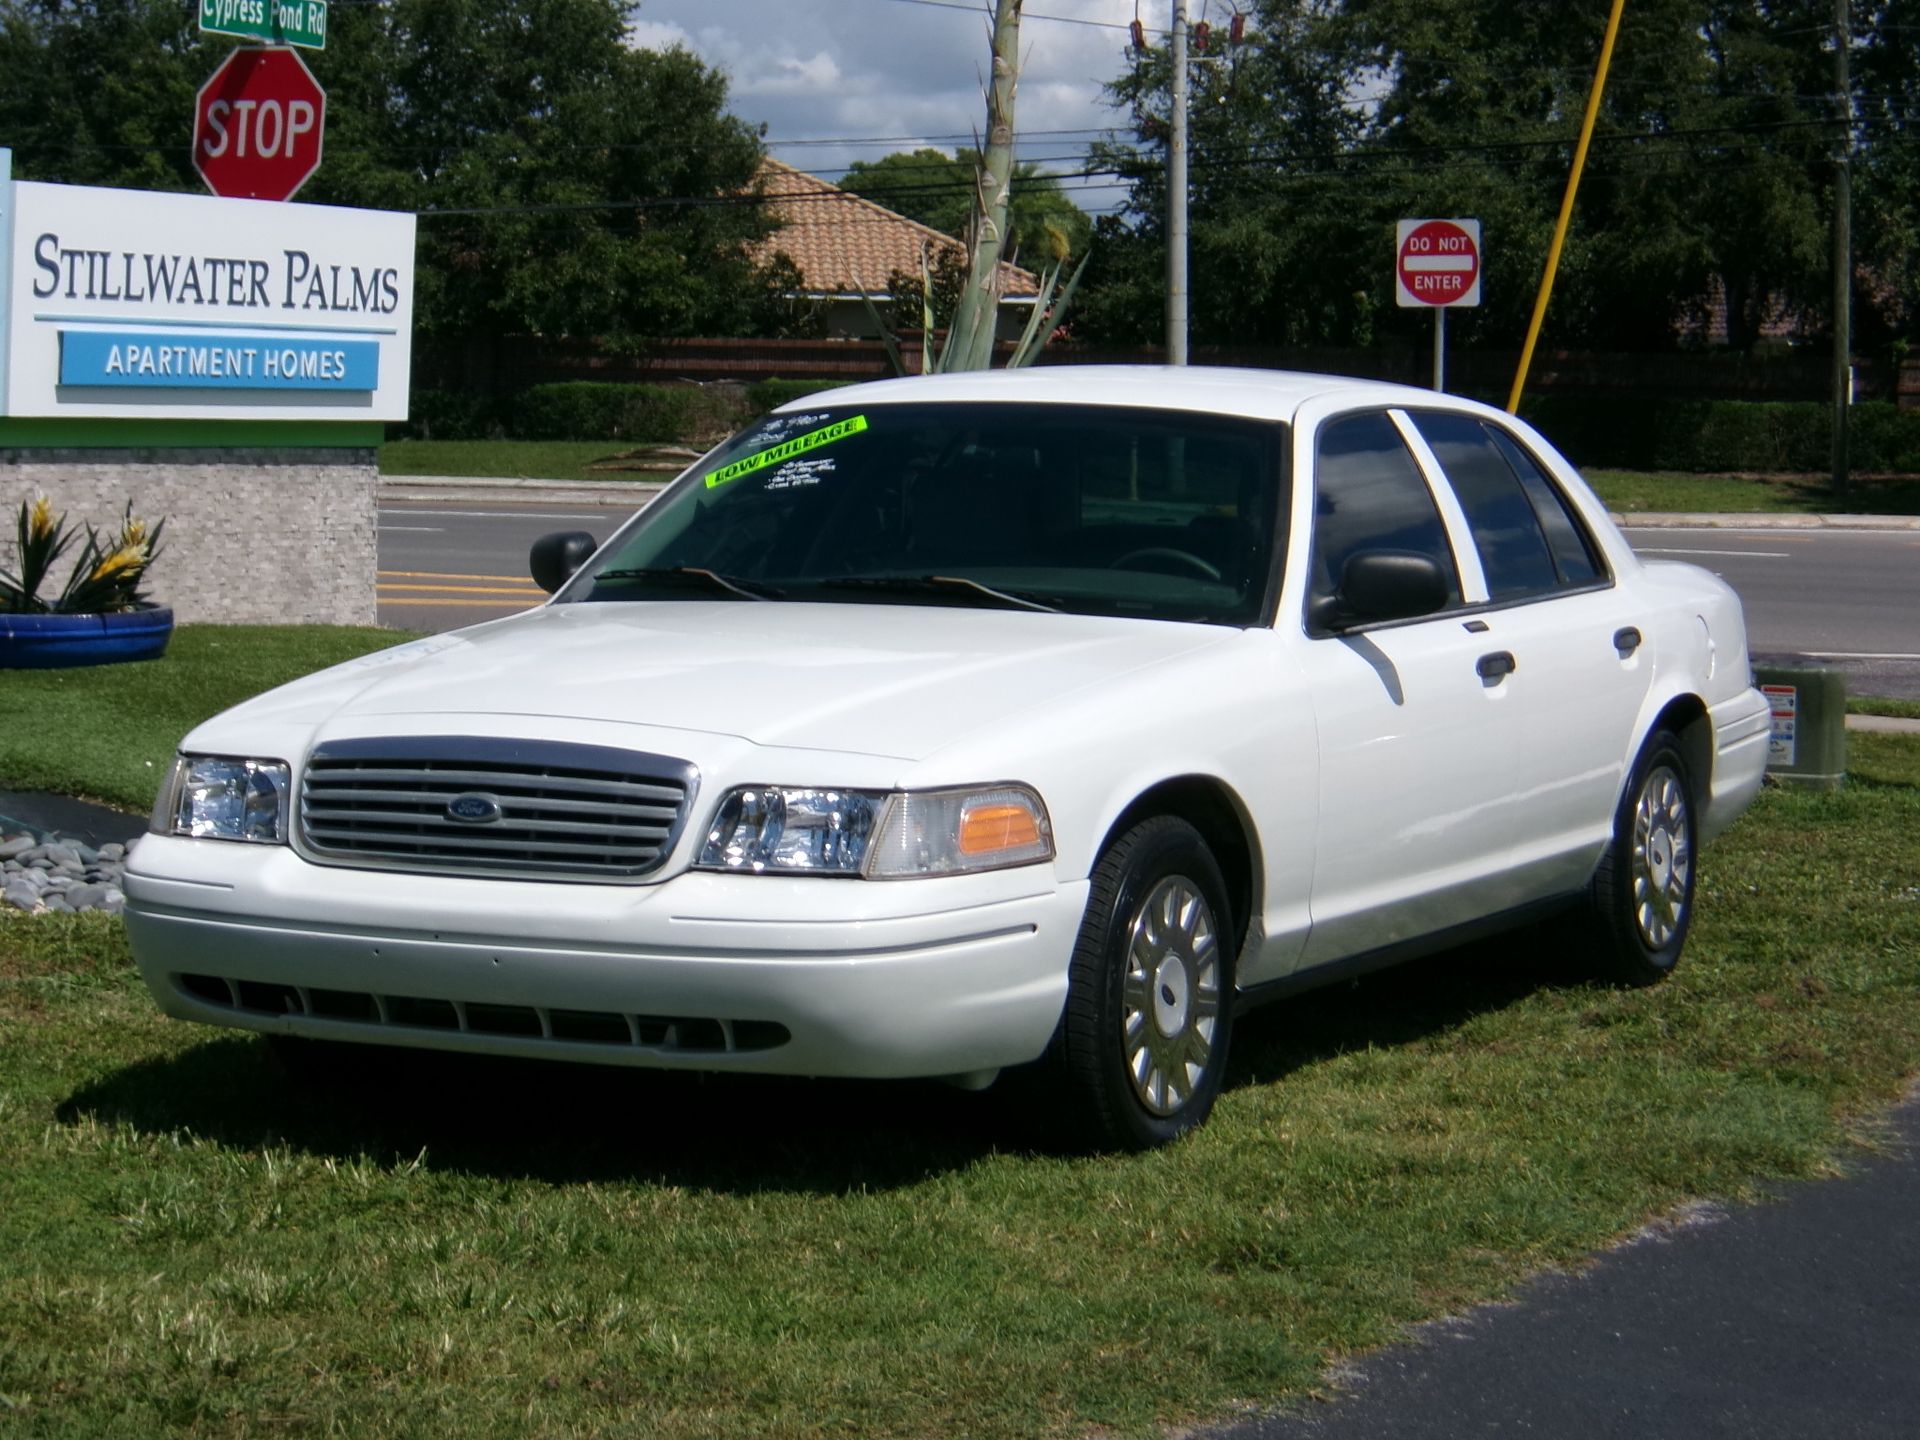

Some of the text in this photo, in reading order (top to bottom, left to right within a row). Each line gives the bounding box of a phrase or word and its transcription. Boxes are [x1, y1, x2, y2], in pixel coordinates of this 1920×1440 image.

[203, 0, 324, 35] Cypress Pond Rd
[203, 99, 315, 158] STOP
[1409, 236, 1467, 252] DO NOT
[33, 232, 399, 314] STILLWATER PALMS
[1414, 275, 1461, 290] ENTER
[105, 344, 346, 380] APARTMENT HOMES
[714, 456, 760, 483] LOW
[764, 418, 859, 464] MILEAGE
